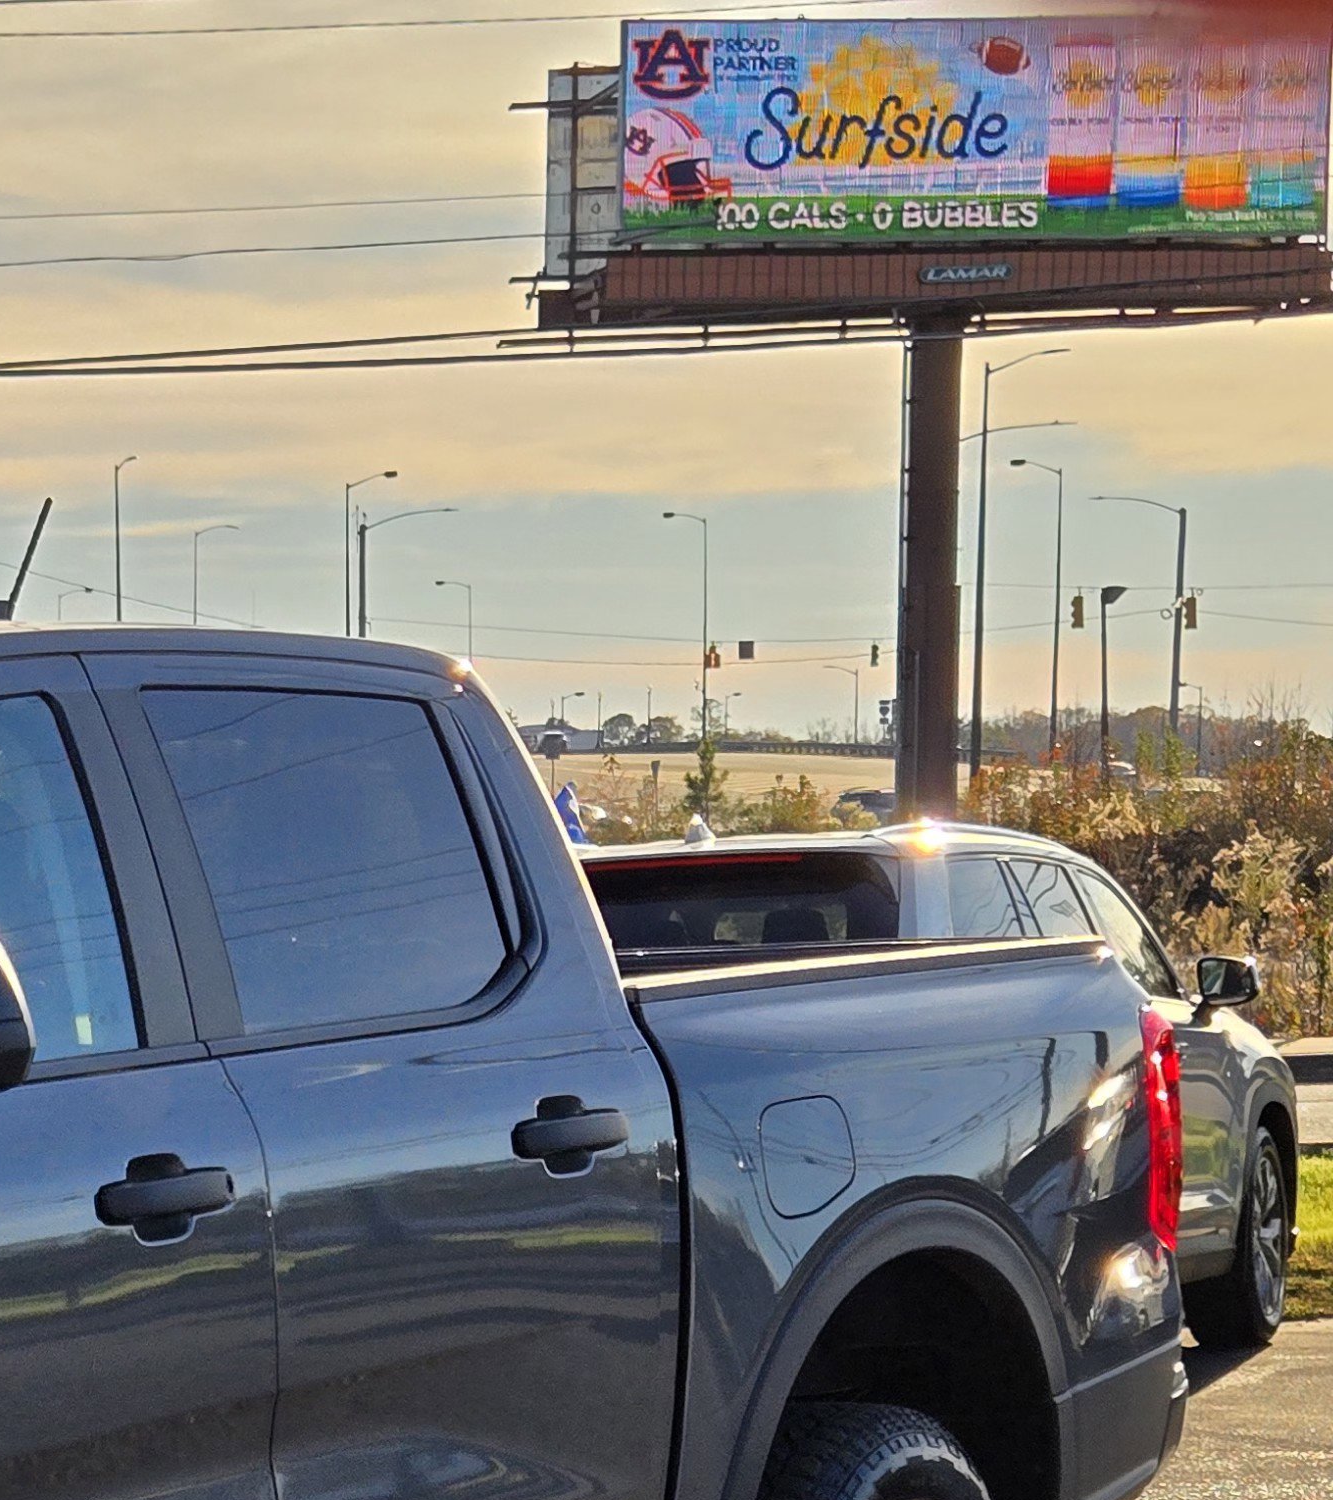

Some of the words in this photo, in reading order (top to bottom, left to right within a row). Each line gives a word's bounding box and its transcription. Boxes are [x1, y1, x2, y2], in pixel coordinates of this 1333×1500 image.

[713, 37, 780, 53] PROUD
[713, 55, 797, 72] PARTNER
[745, 86, 1008, 170] Surfside
[767, 202, 847, 230] CALS
[901, 201, 1039, 229] BUBBLES
[926, 265, 1008, 281] LAMAR
